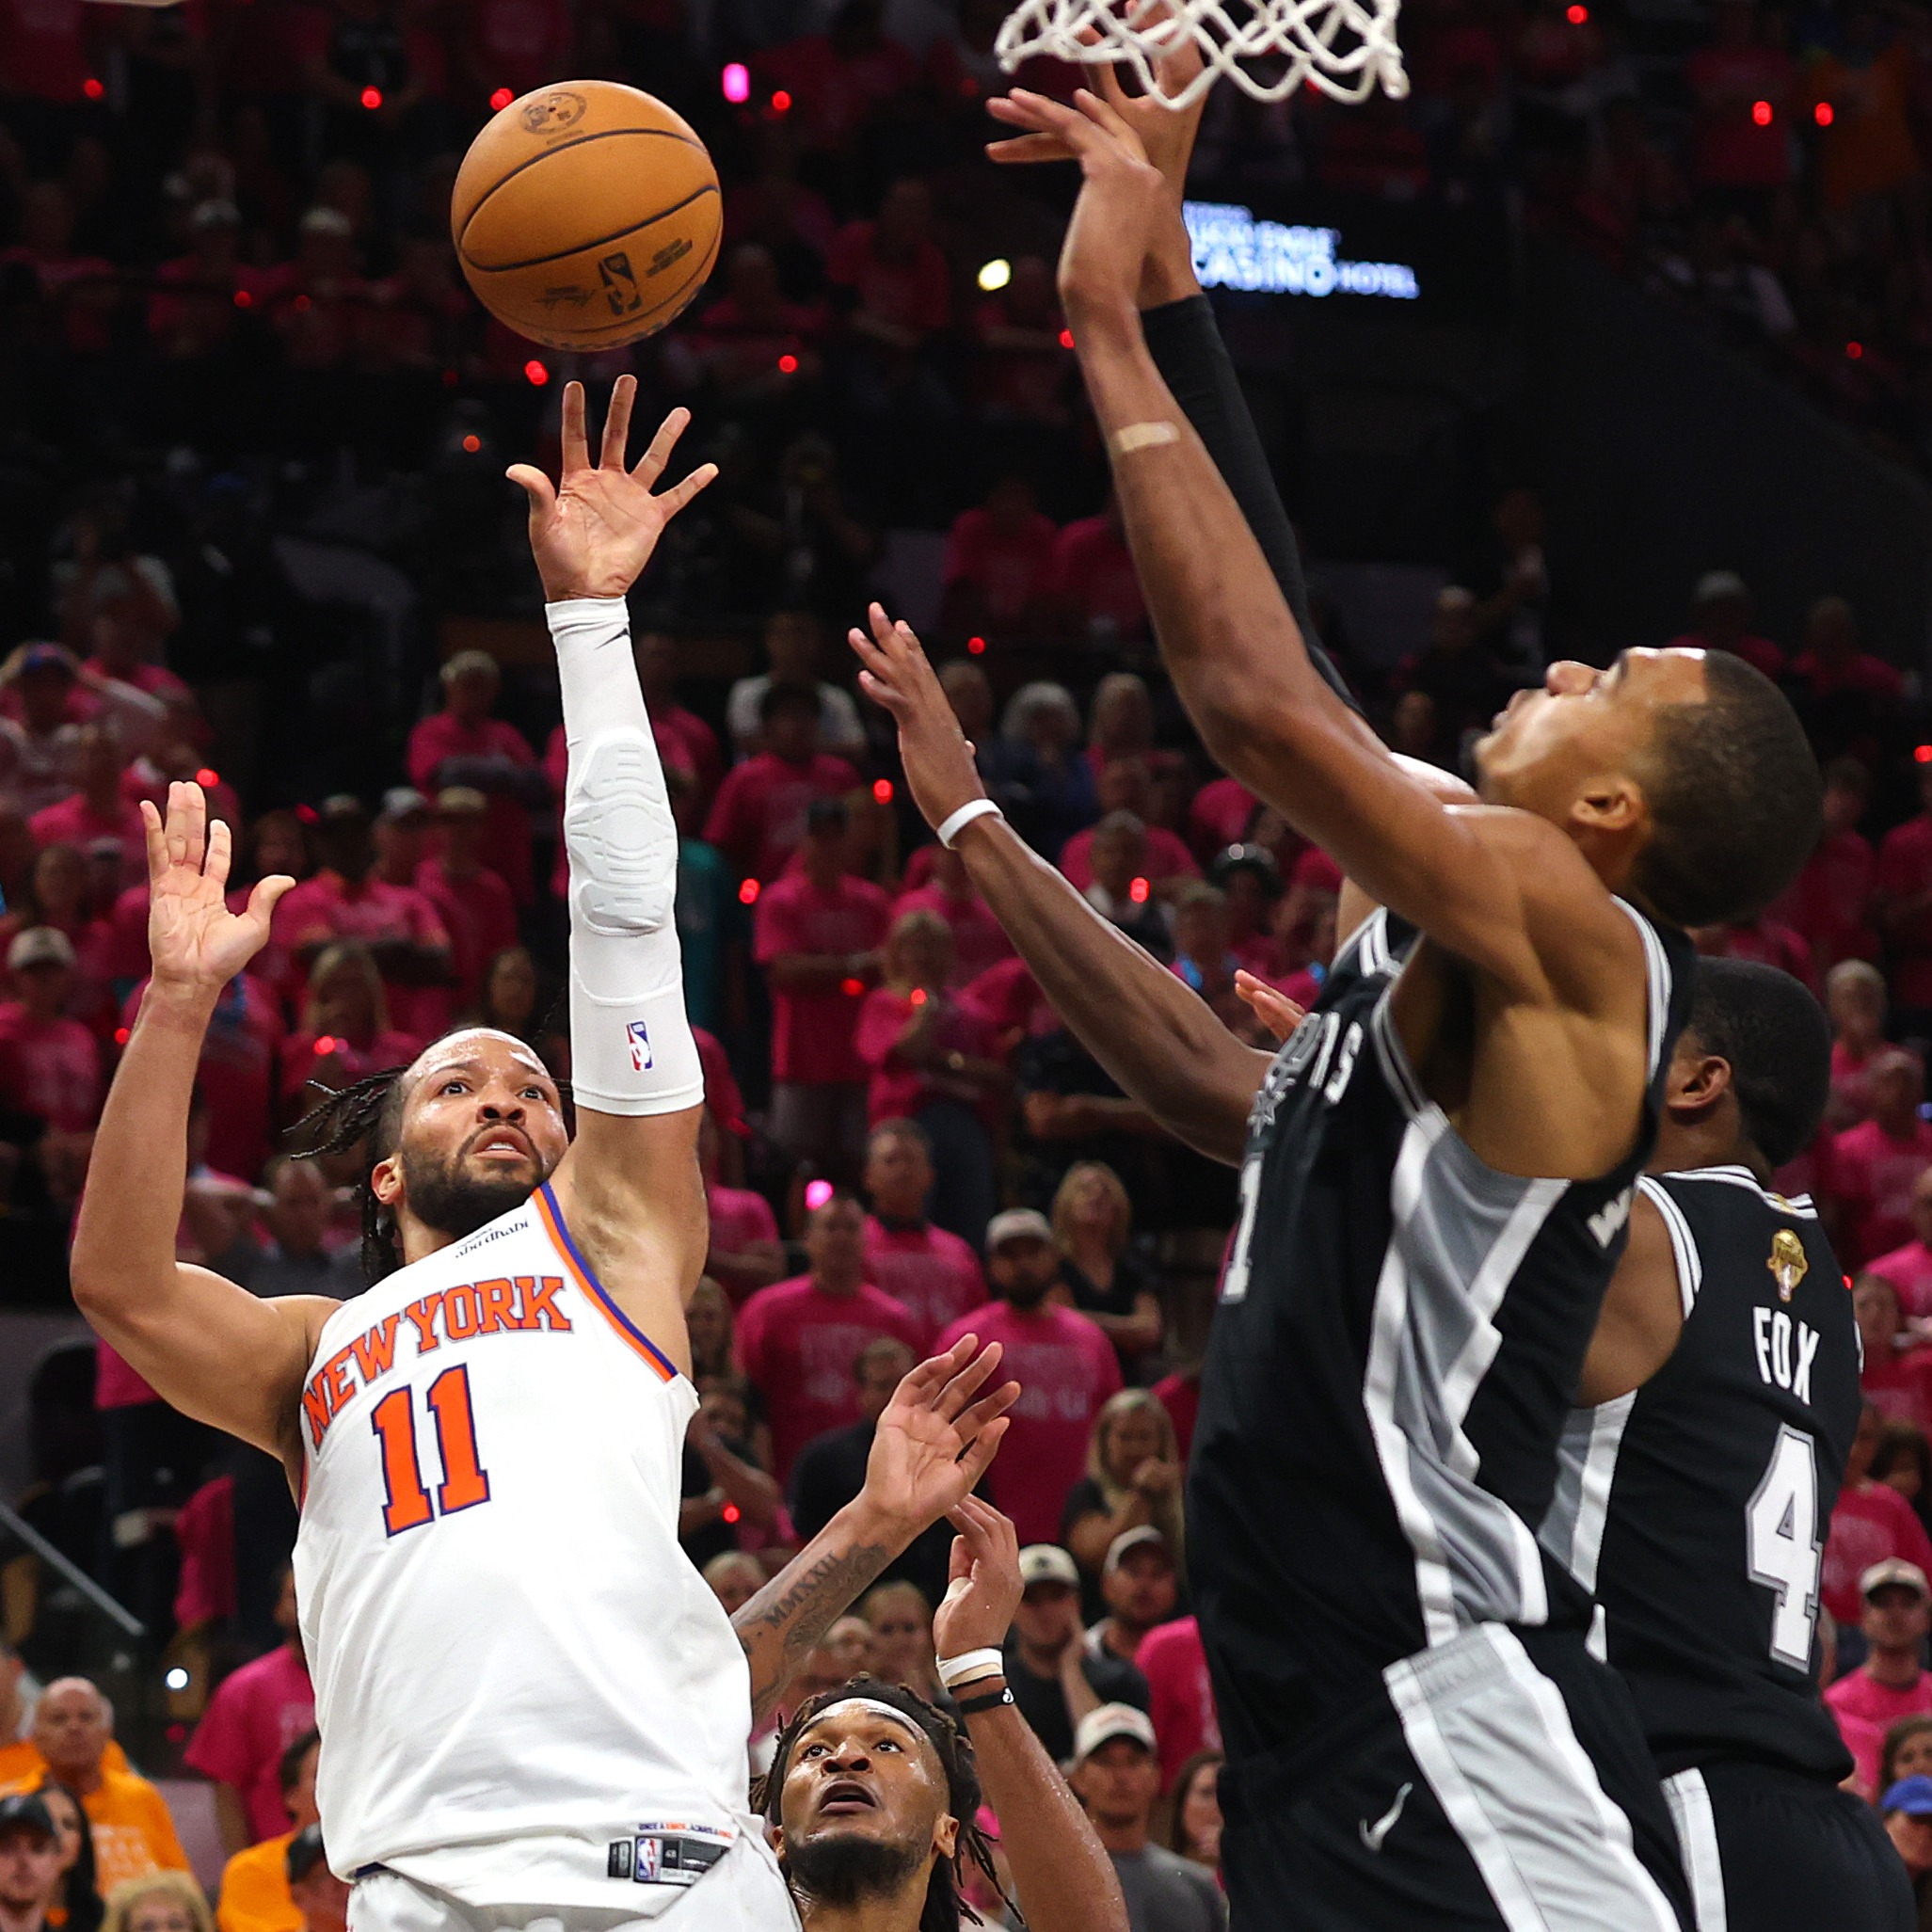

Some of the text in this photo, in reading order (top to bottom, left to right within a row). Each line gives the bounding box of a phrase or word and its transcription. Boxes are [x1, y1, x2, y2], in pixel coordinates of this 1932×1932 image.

[485, 1218, 529, 1243] dhabi
[302, 1275, 575, 1457] NEW YORK
[1753, 1306, 1820, 1405] FOX
[371, 1362, 491, 1538] 11
[1745, 1422, 1824, 1674] 4
